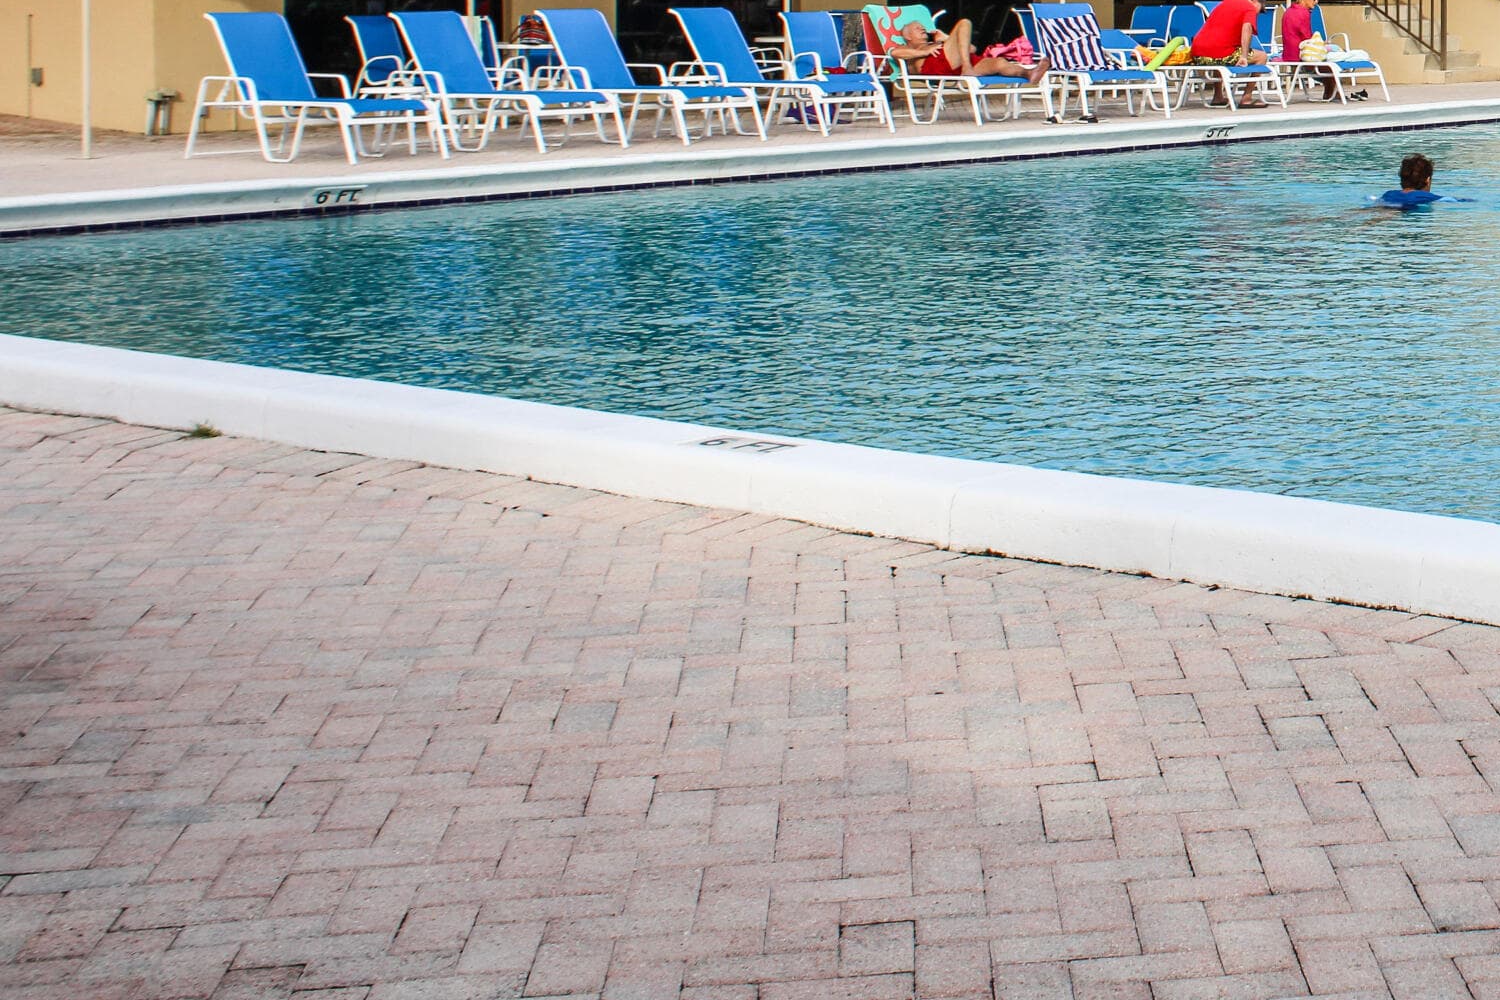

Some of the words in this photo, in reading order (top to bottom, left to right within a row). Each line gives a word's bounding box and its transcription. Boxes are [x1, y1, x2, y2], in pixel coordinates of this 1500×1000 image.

[1206, 127, 1218, 138] 5
[316, 190, 331, 204] 6
[699, 436, 739, 446] 6
